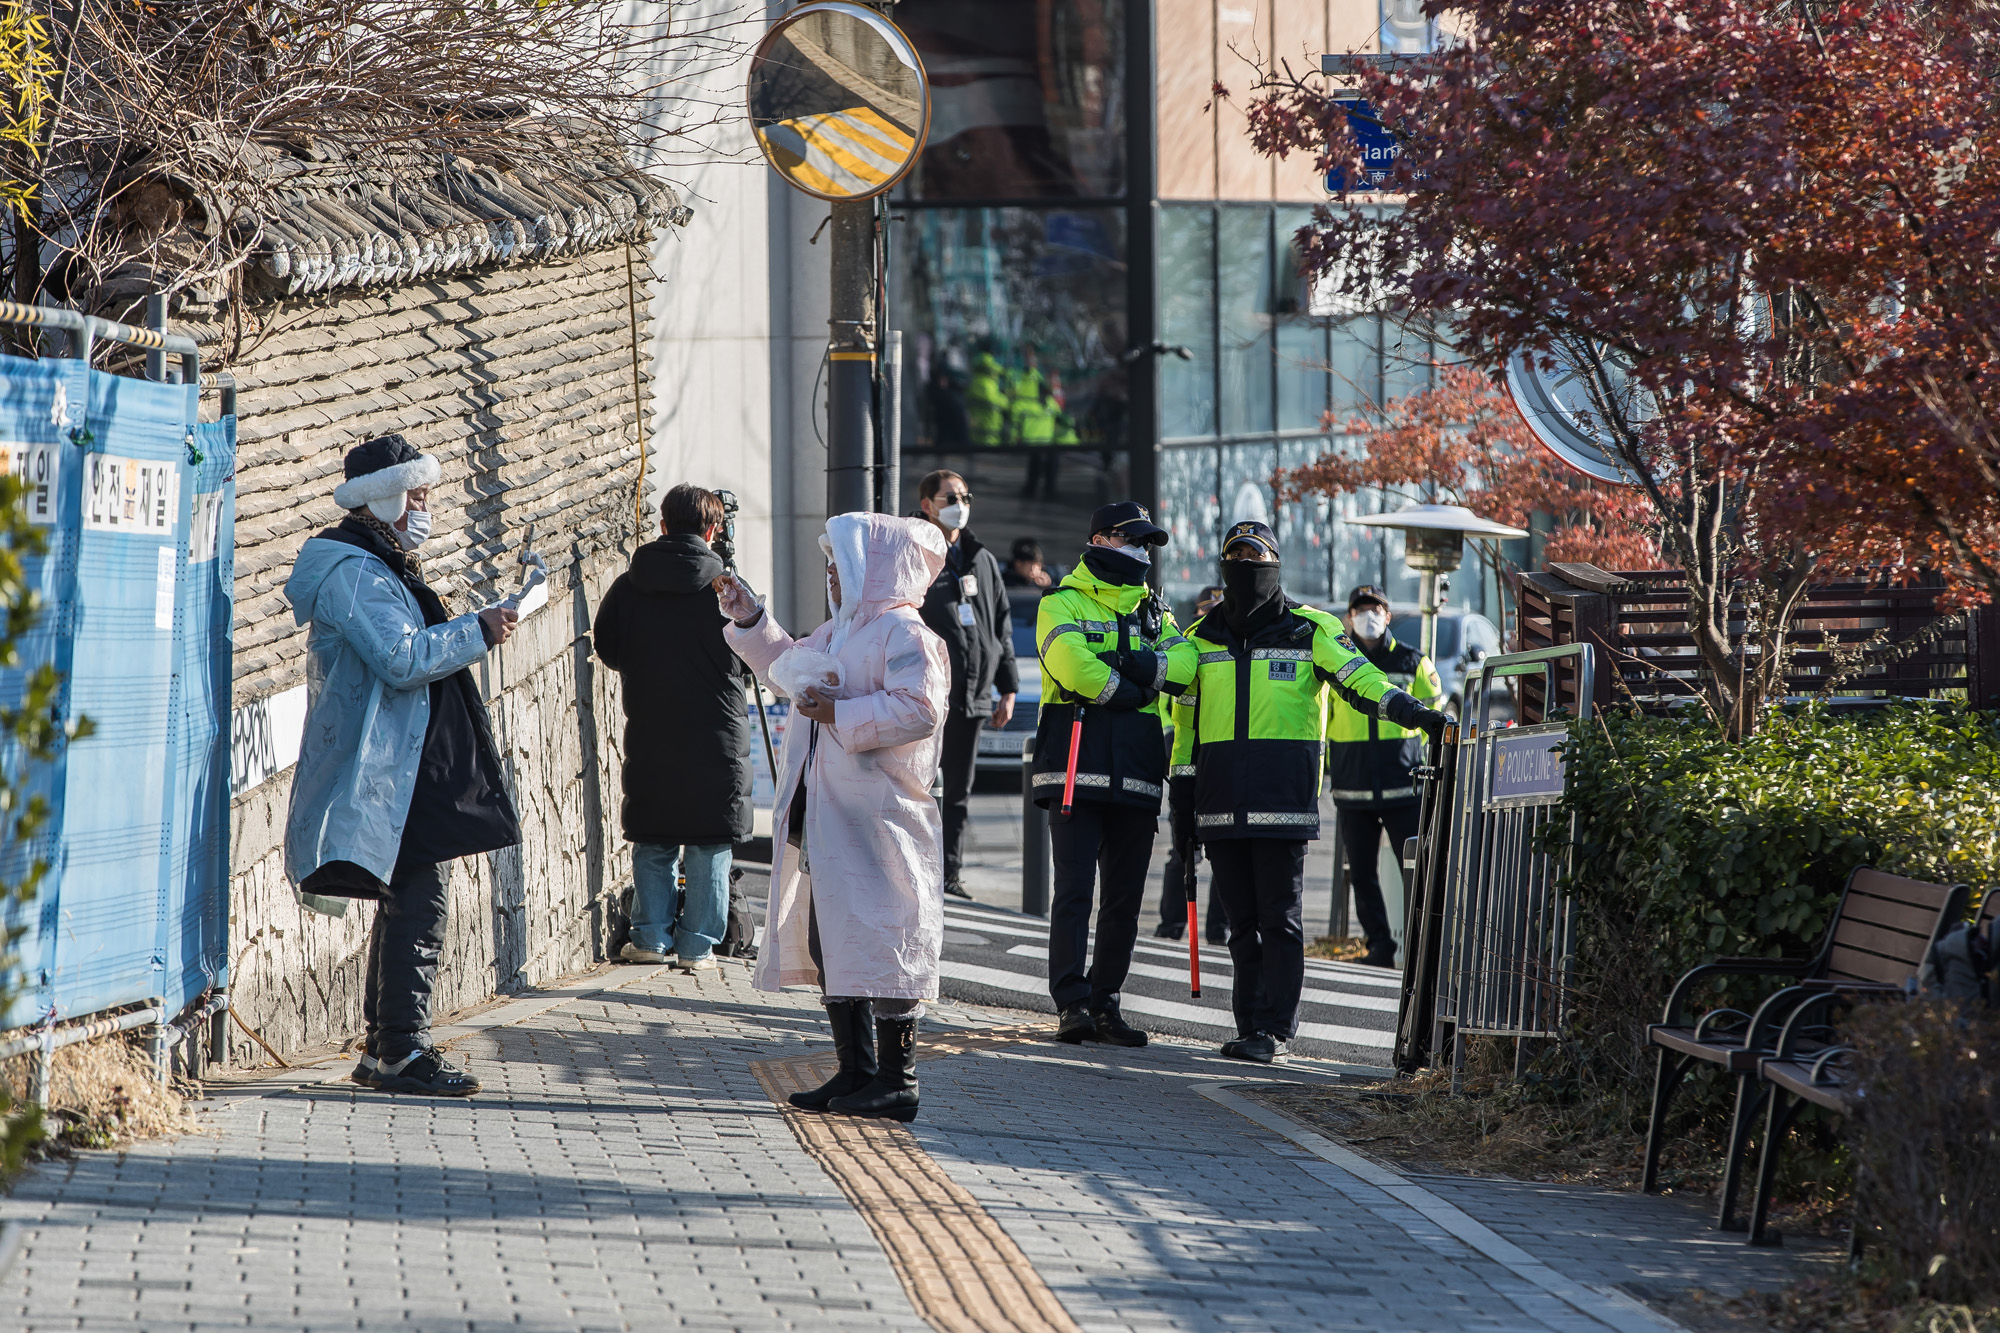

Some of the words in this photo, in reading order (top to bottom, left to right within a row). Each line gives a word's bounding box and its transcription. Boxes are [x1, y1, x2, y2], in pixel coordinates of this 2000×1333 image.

[93, 460, 121, 525] 안전
[139, 467, 168, 527] 제일
[1506, 749, 1534, 784] POLICE
[1534, 747, 1551, 781] LINE
